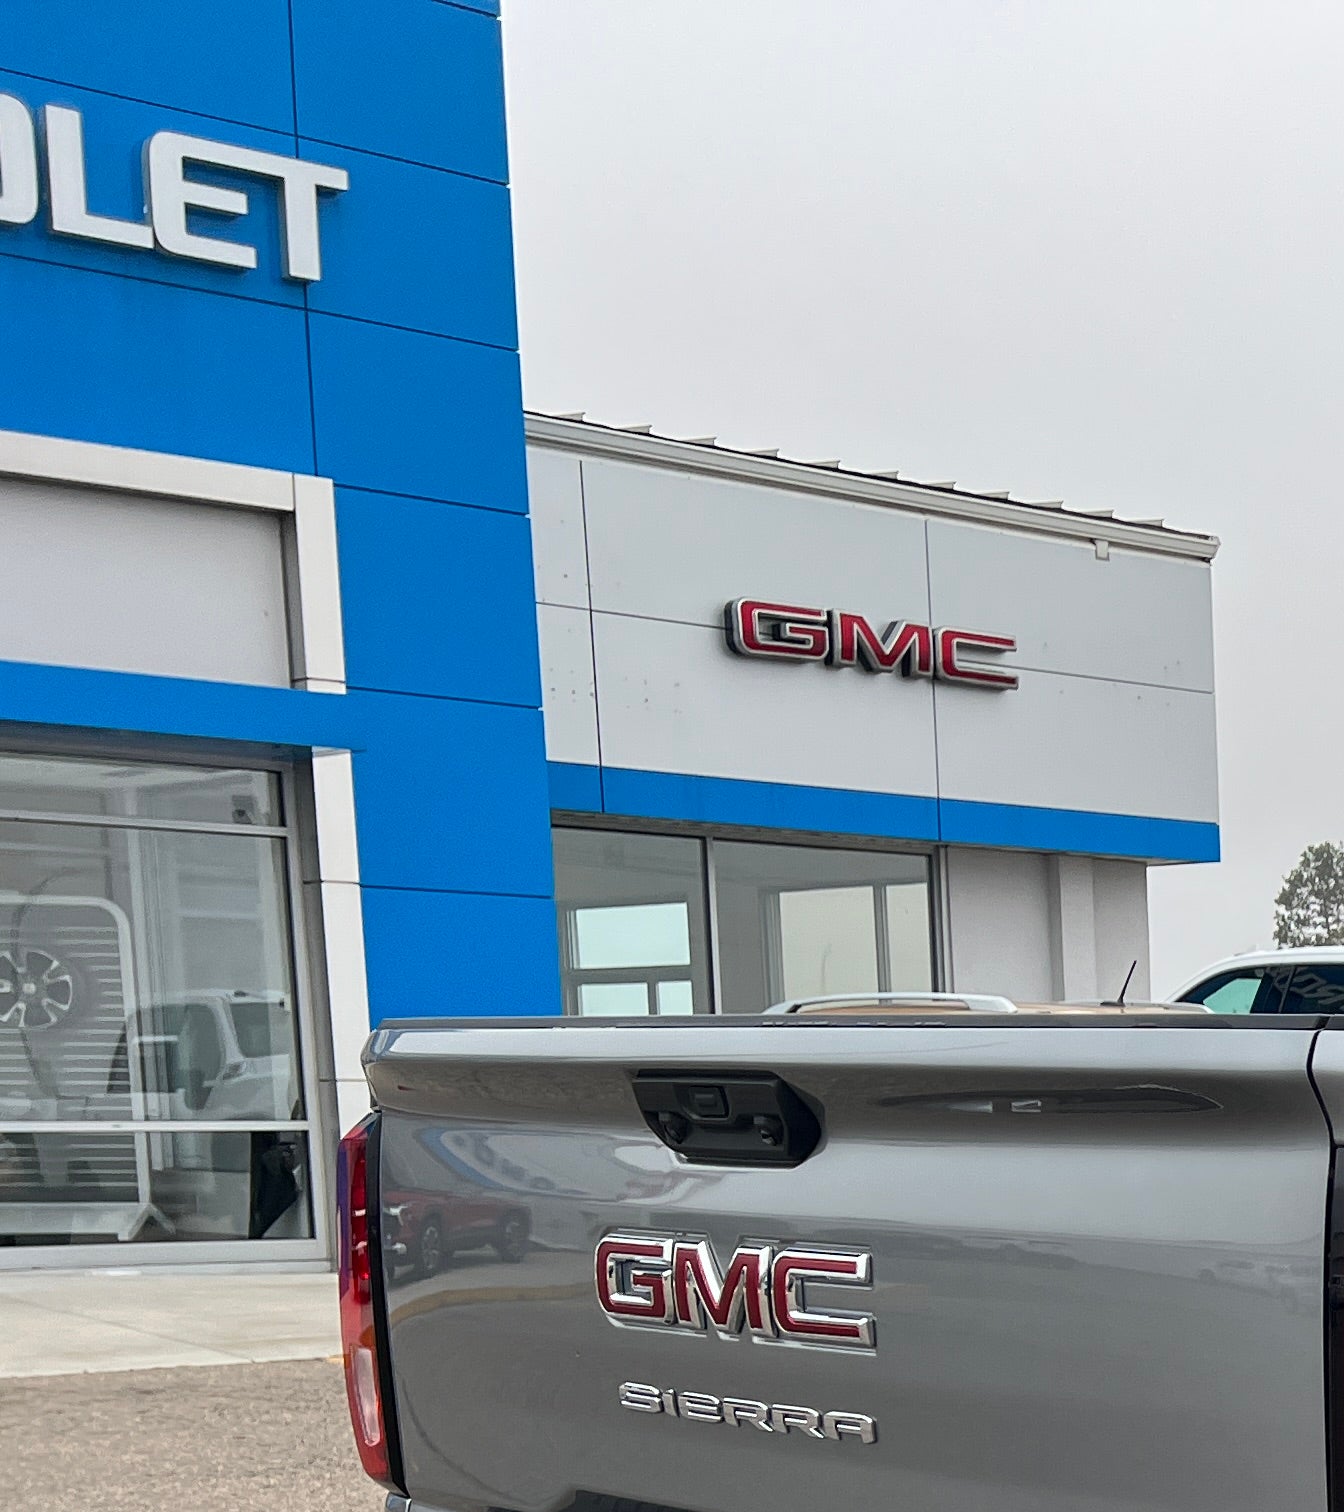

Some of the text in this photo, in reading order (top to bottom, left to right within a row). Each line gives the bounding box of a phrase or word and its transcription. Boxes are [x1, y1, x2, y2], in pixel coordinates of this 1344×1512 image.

[724, 597, 1019, 690] GMC
[594, 1230, 877, 1351] GMC
[618, 1380, 878, 1444] SIERRA
